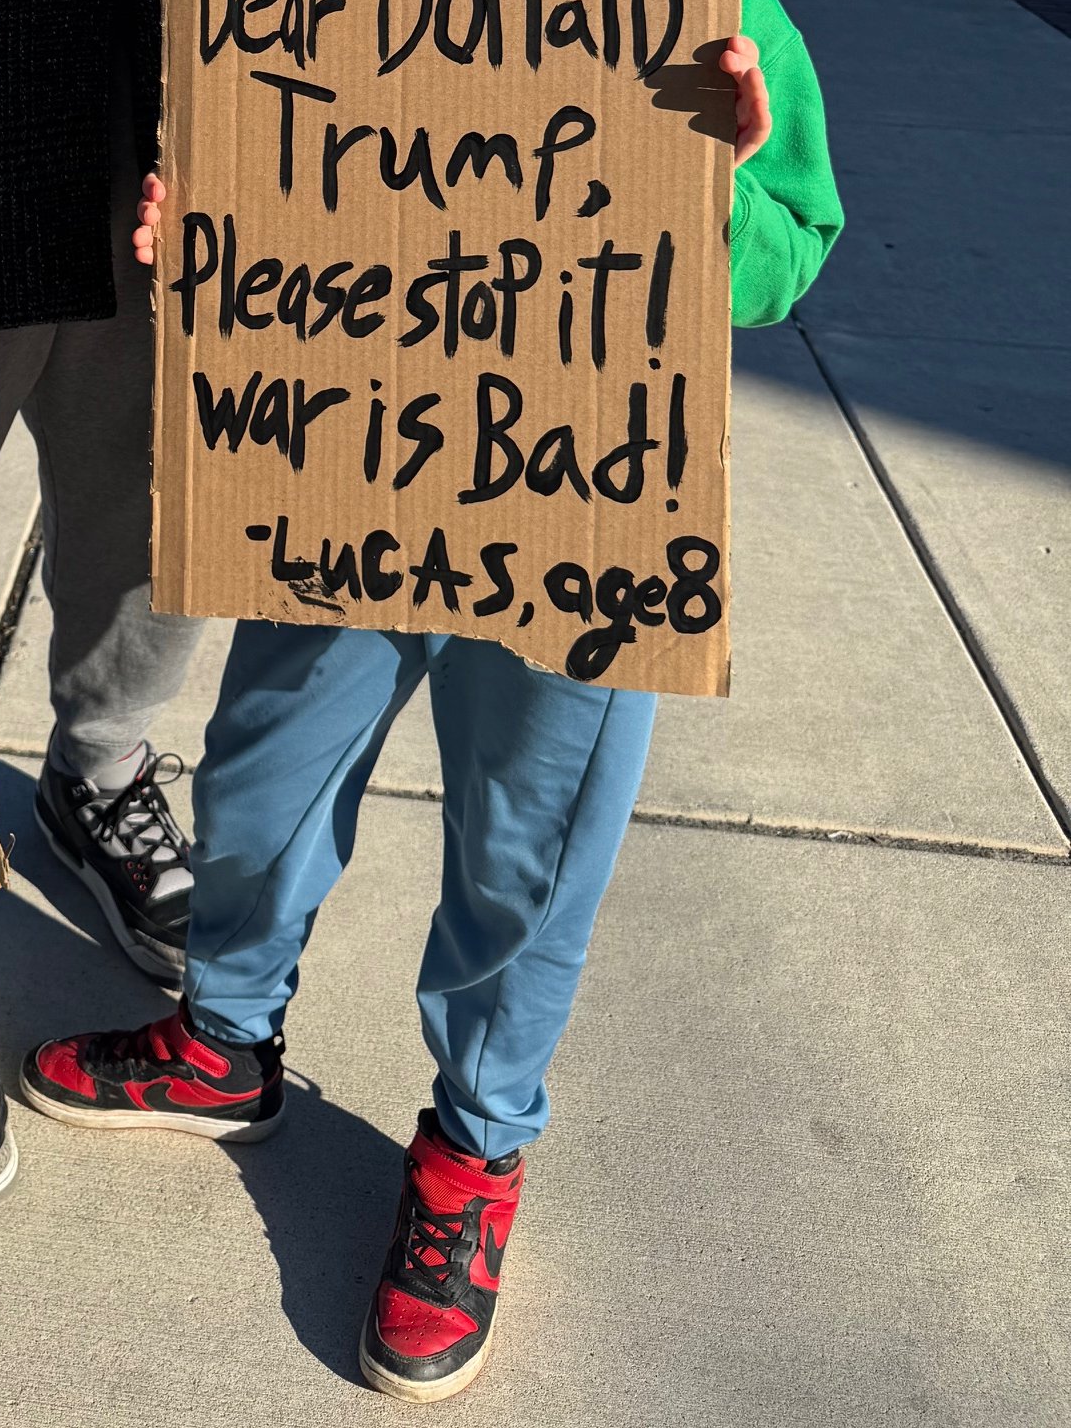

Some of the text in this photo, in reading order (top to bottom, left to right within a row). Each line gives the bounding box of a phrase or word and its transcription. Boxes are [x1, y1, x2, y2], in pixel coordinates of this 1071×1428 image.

[249, 70, 613, 223] Trump,
[169, 211, 388, 346] Please
[362, 379, 444, 492] is
[456, 372, 688, 515] Bad!
